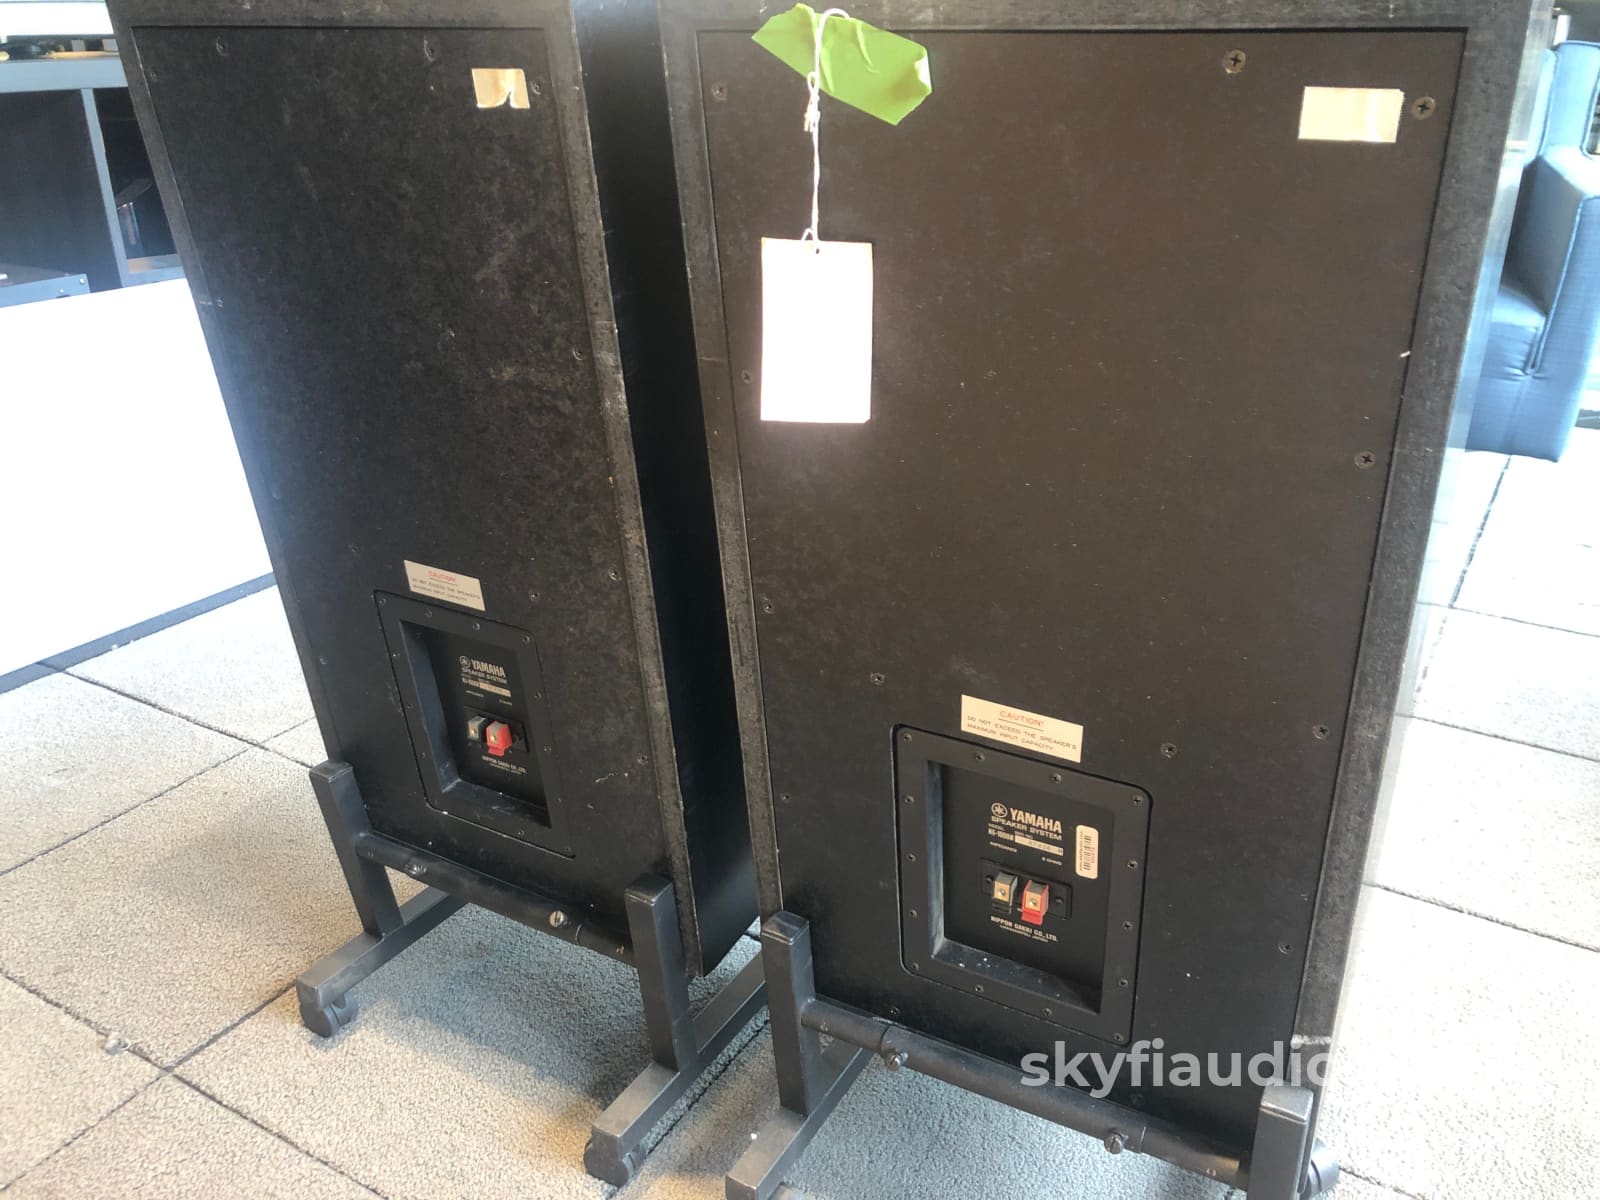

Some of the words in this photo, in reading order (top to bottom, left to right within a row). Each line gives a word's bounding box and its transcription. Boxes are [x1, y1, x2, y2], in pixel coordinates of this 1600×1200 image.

[470, 659, 507, 678] YAMAHA
[1000, 709, 1045, 727] CAUTION!
[967, 715, 977, 723] DO
[979, 718, 991, 726] NOT
[994, 723, 1021, 734] EXCEED
[1024, 731, 1037, 739] THE
[1040, 735, 1077, 750] SPEAKER'S
[999, 732, 1018, 742] INPUT
[1021, 738, 1054, 750] CAPACITY
[991, 815, 1028, 831] SPEAKER
[1029, 826, 1063, 841] SYSTEM
[1010, 807, 1063, 834] YAMAHA
[991, 915, 1013, 928] NIPPON
